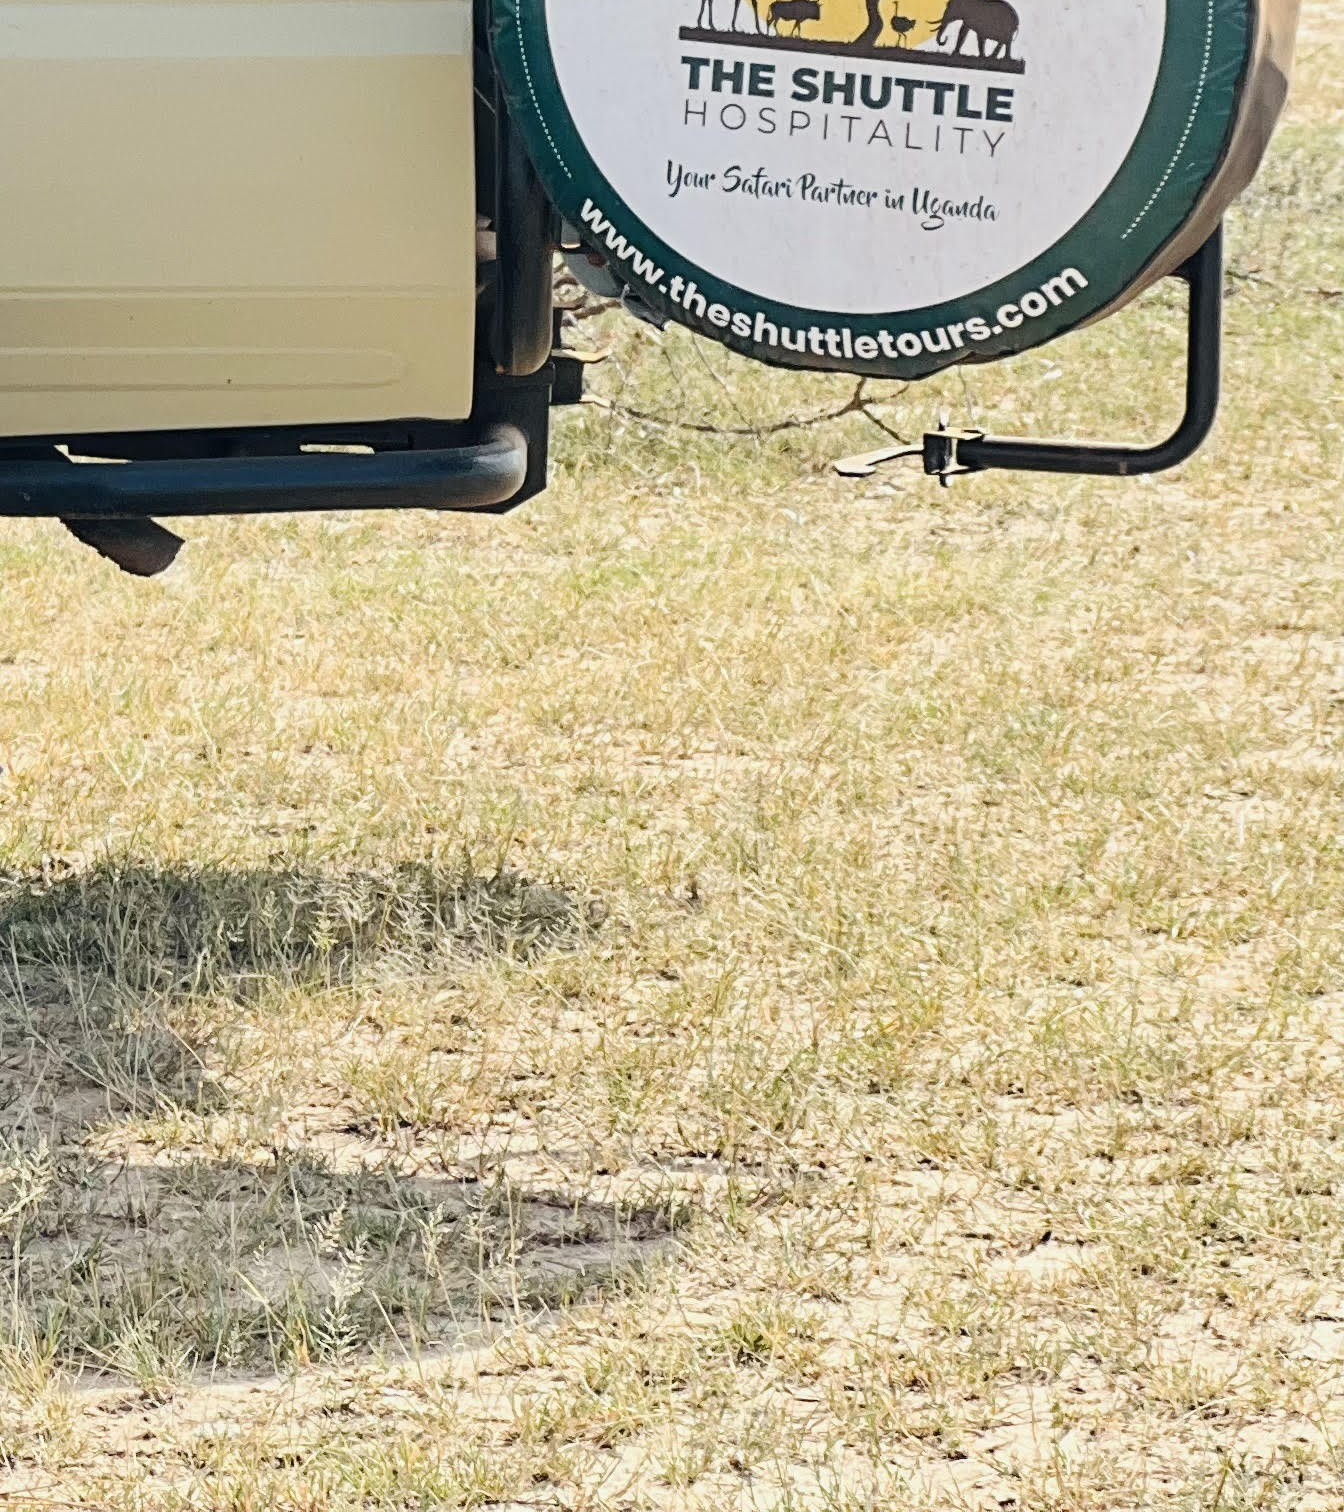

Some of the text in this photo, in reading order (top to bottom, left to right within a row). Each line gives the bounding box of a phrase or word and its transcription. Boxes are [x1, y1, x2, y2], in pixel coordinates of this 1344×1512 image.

[680, 55, 1016, 124] THE SHUTTLE
[683, 98, 1007, 159] HOSPITALITY
[666, 159, 1001, 232] Your Safari Partner in Uganda
[579, 197, 1089, 360] www.theshuttletours.com
